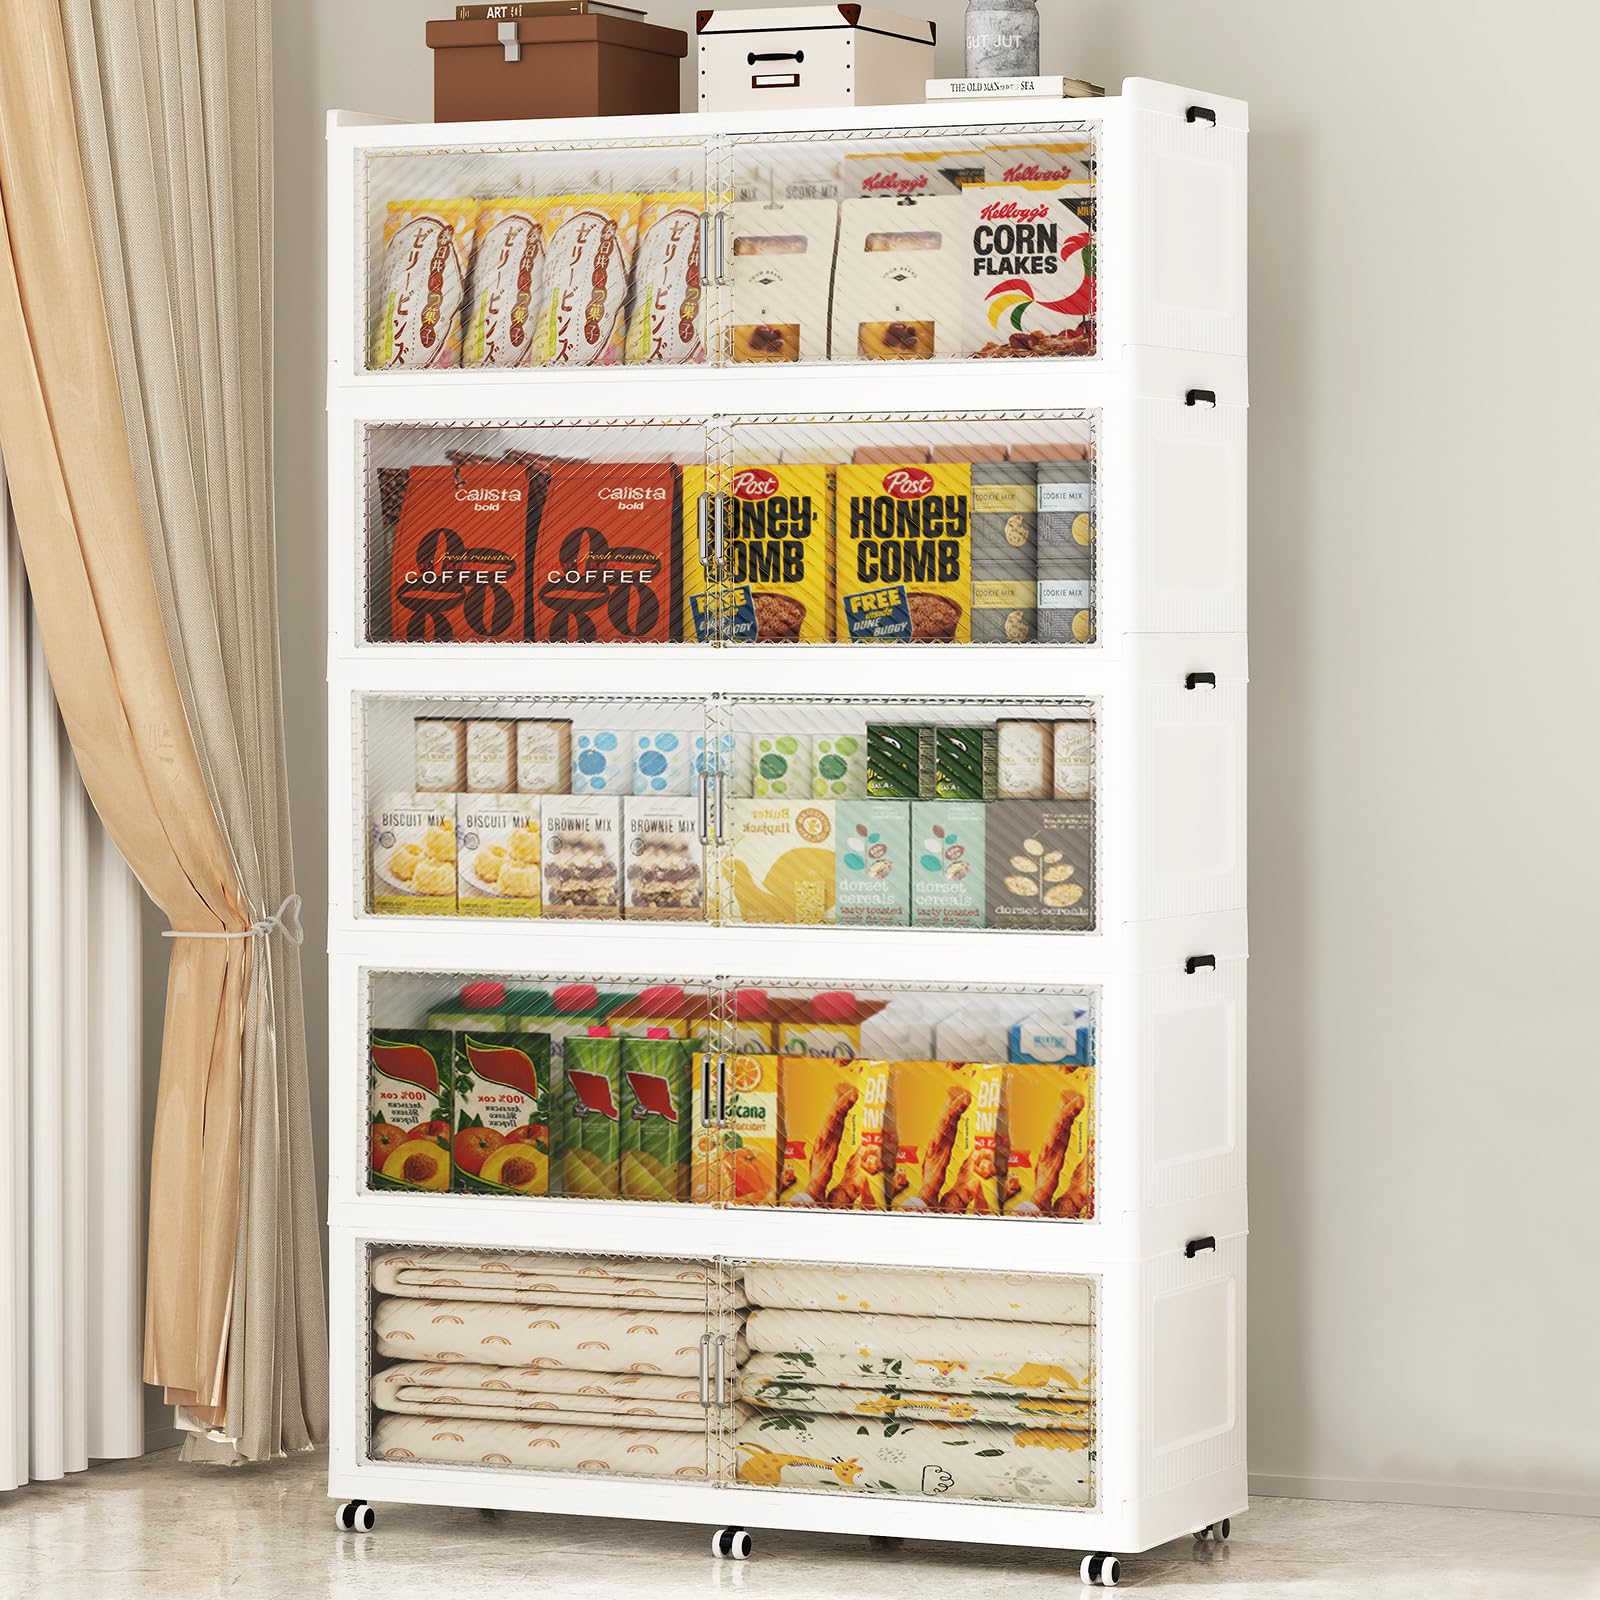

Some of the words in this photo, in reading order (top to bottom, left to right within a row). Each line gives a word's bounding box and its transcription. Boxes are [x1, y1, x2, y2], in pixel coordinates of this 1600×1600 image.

[487, 6, 508, 19] ART
[993, 34, 1022, 48] JUT
[951, 83, 966, 92] THE
[967, 82, 982, 92] OLD
[984, 82, 1000, 91] MAN
[1020, 81, 1035, 90] SEA
[862, 172, 929, 192] Kellogg's
[821, 184, 839, 199] MIX
[980, 201, 1049, 223] Kellogg's
[973, 223, 1058, 256] CORN
[973, 256, 1058, 276] FLAKES
[734, 472, 777, 495] Post
[887, 471, 932, 494] Post
[976, 493, 999, 501] COOKIE
[1042, 492, 1066, 500] COOKIE
[1068, 492, 1083, 500] MIX
[474, 503, 500, 511] bold
[618, 502, 644, 510] bold
[430, 552, 467, 564] fresh
[573, 551, 611, 563] fresh
[857, 540, 961, 583] COMB
[405, 571, 508, 584] COFFEE
[547, 570, 652, 583] COFFEE
[976, 589, 999, 597] COOKIE
[1042, 589, 1066, 597] COOKIE
[1068, 589, 1083, 597] MIX
[850, 588, 902, 615] FREE
[853, 617, 881, 631] DUNE
[874, 621, 908, 637] BUGGY
[382, 813, 422, 827] BISCUIT
[427, 814, 446, 827] MIX
[466, 815, 506, 828] BISCUIT
[512, 816, 531, 828] MIX
[547, 818, 590, 832] BROWNIE
[595, 818, 613, 832] MIX
[631, 819, 673, 833] BROWNIE
[678, 820, 696, 833] MIX
[840, 880, 888, 892] dorset
[916, 881, 966, 893] dorset
[839, 893, 895, 905] cereals
[916, 895, 972, 906] cereals
[867, 906, 902, 915] toasted
[943, 908, 980, 917] toasted
[995, 905, 1039, 915] dorset
[1041, 907, 1089, 916] cereals
